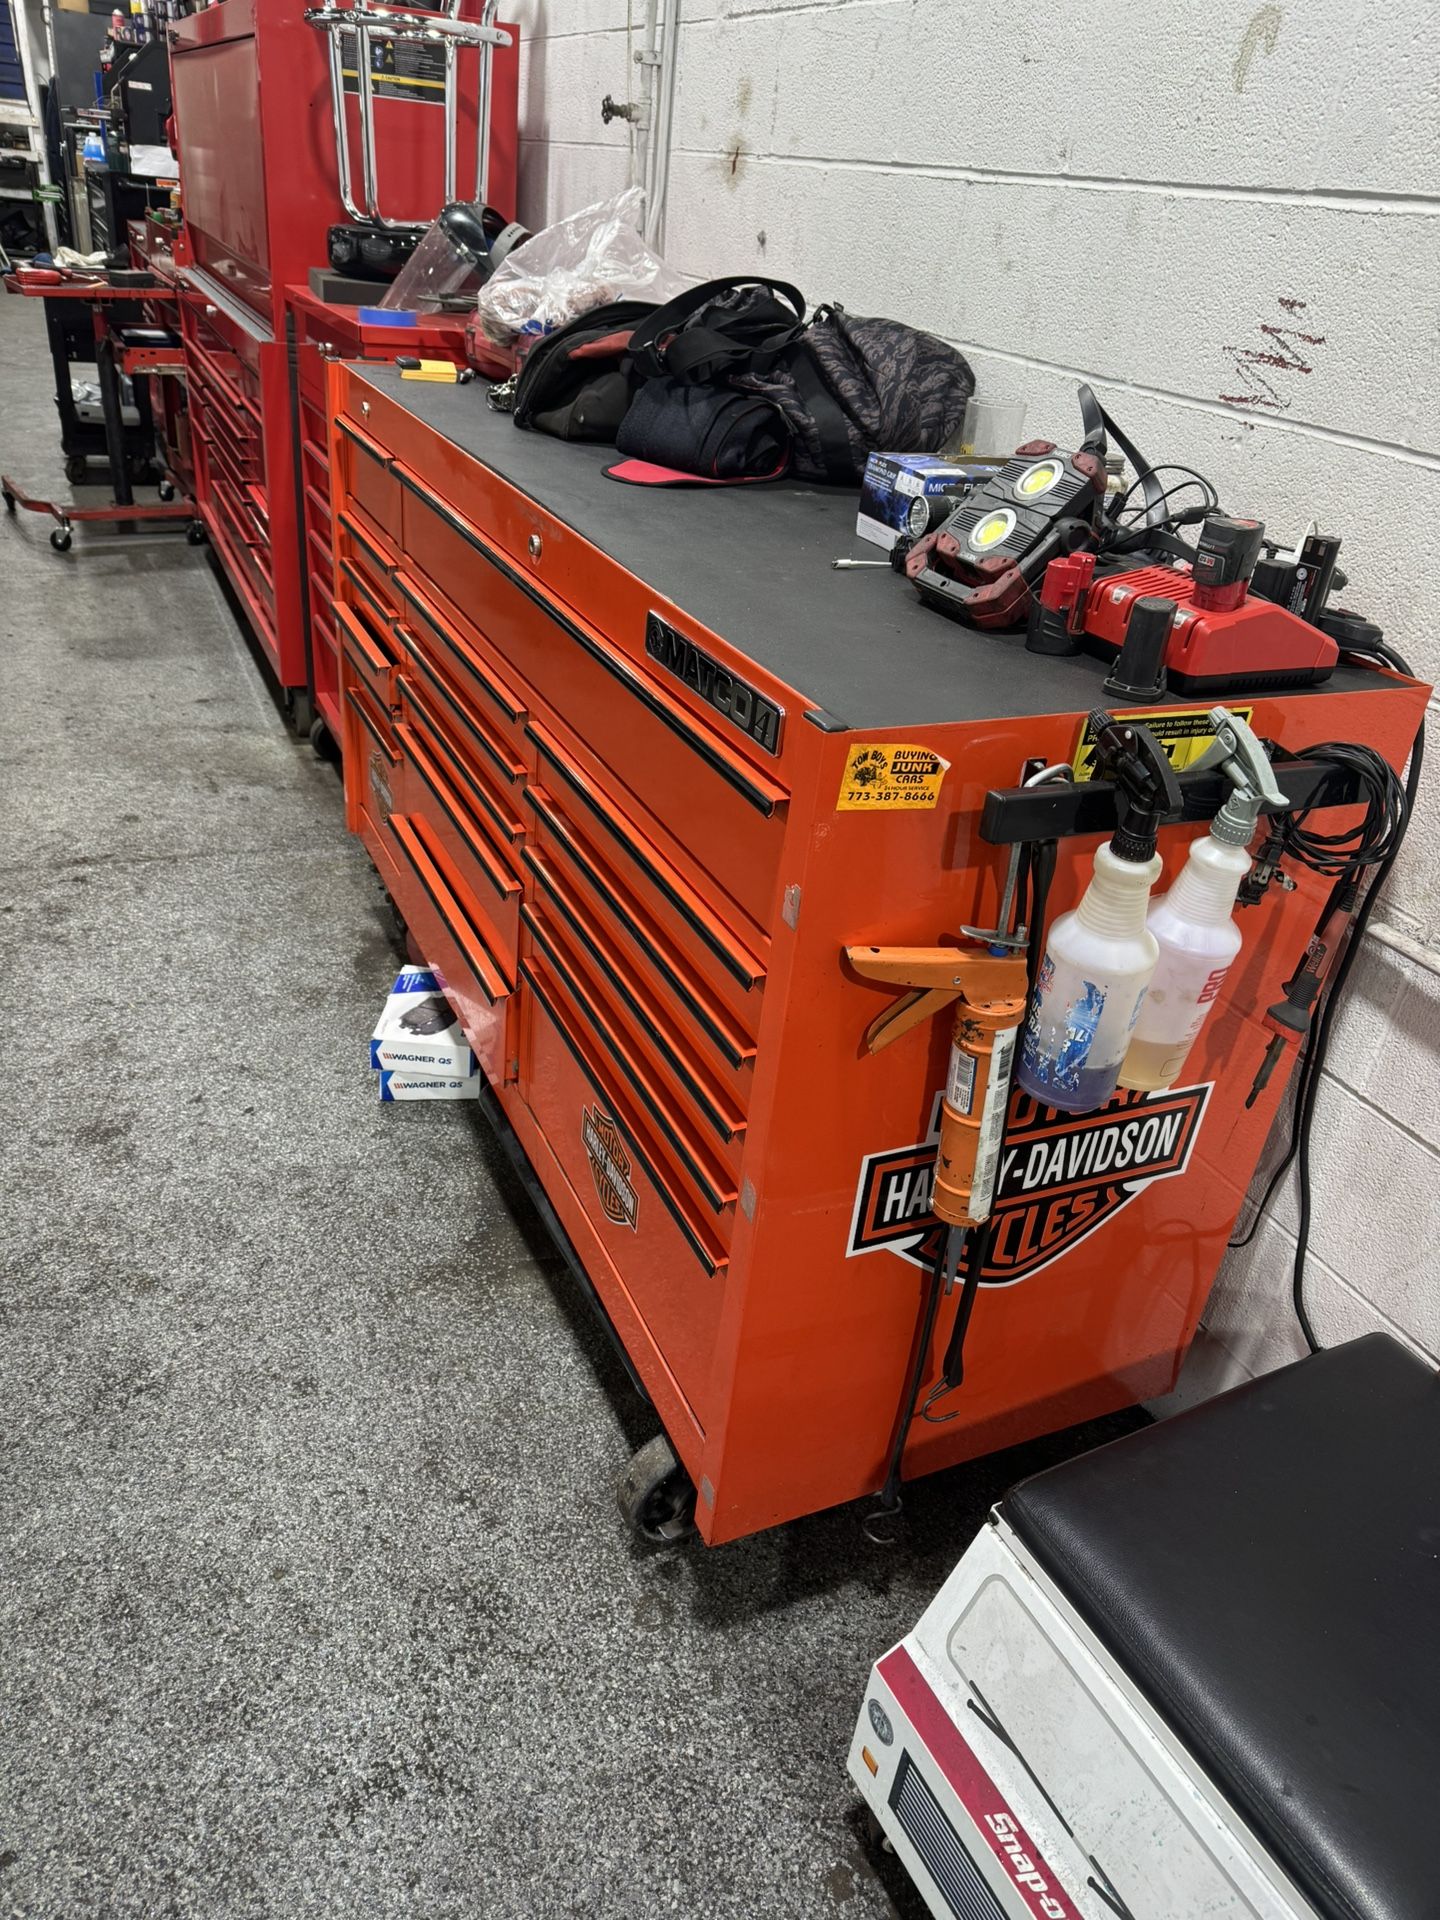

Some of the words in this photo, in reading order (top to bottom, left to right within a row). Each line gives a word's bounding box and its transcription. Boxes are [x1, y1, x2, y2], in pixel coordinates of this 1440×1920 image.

[667, 629, 752, 729] MATCO
[1174, 719, 1193, 727] follow
[1165, 728, 1183, 736] result
[1190, 727, 1207, 736] injury
[894, 750, 938, 760] BUYING
[871, 750, 888, 770] BOYS
[892, 763, 933, 772] JUNK
[896, 775, 924, 784] CARS
[848, 792, 935, 801] 773-387-8666
[392, 1053, 435, 1063] WAGNER
[403, 1081, 446, 1089] WAGNER
[883, 1112, 1183, 1222] HAY-DAVIDSON
[984, 1812, 1069, 1919] Snap-o
